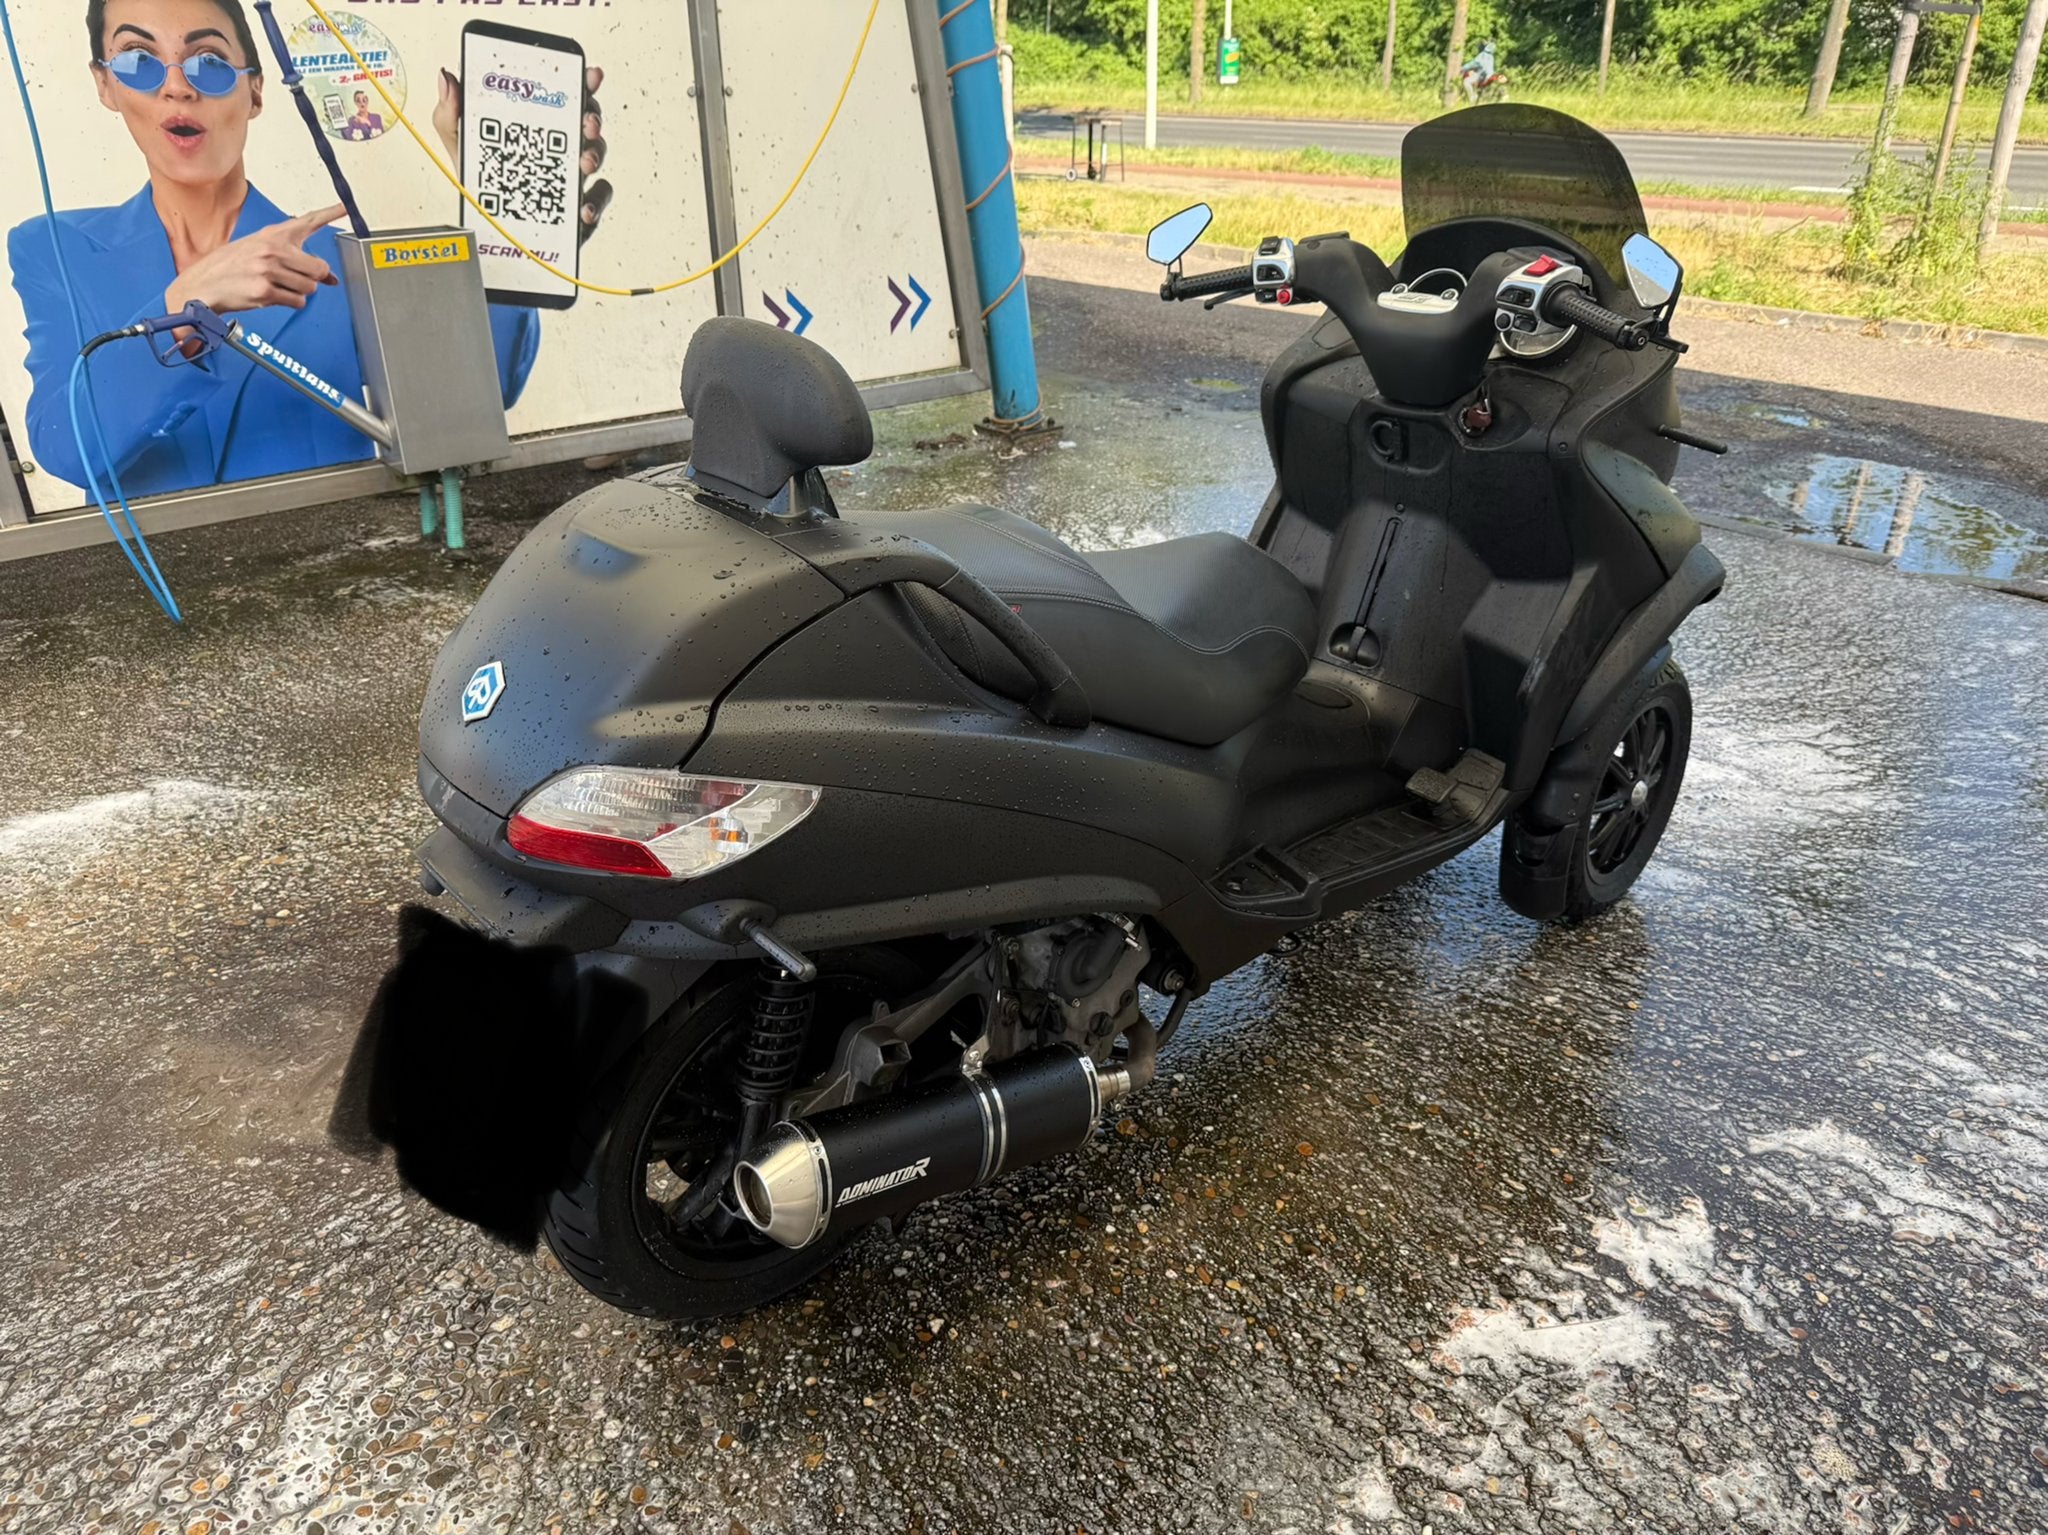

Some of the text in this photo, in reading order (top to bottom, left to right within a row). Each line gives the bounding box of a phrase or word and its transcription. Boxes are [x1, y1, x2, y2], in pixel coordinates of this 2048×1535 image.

[484, 75, 562, 106] easy wash
[385, 242, 458, 263] Borstel
[478, 243, 523, 259] SCAN
[246, 332, 341, 404] Spuitlans
[837, 1156, 931, 1204] DOMINATOR
